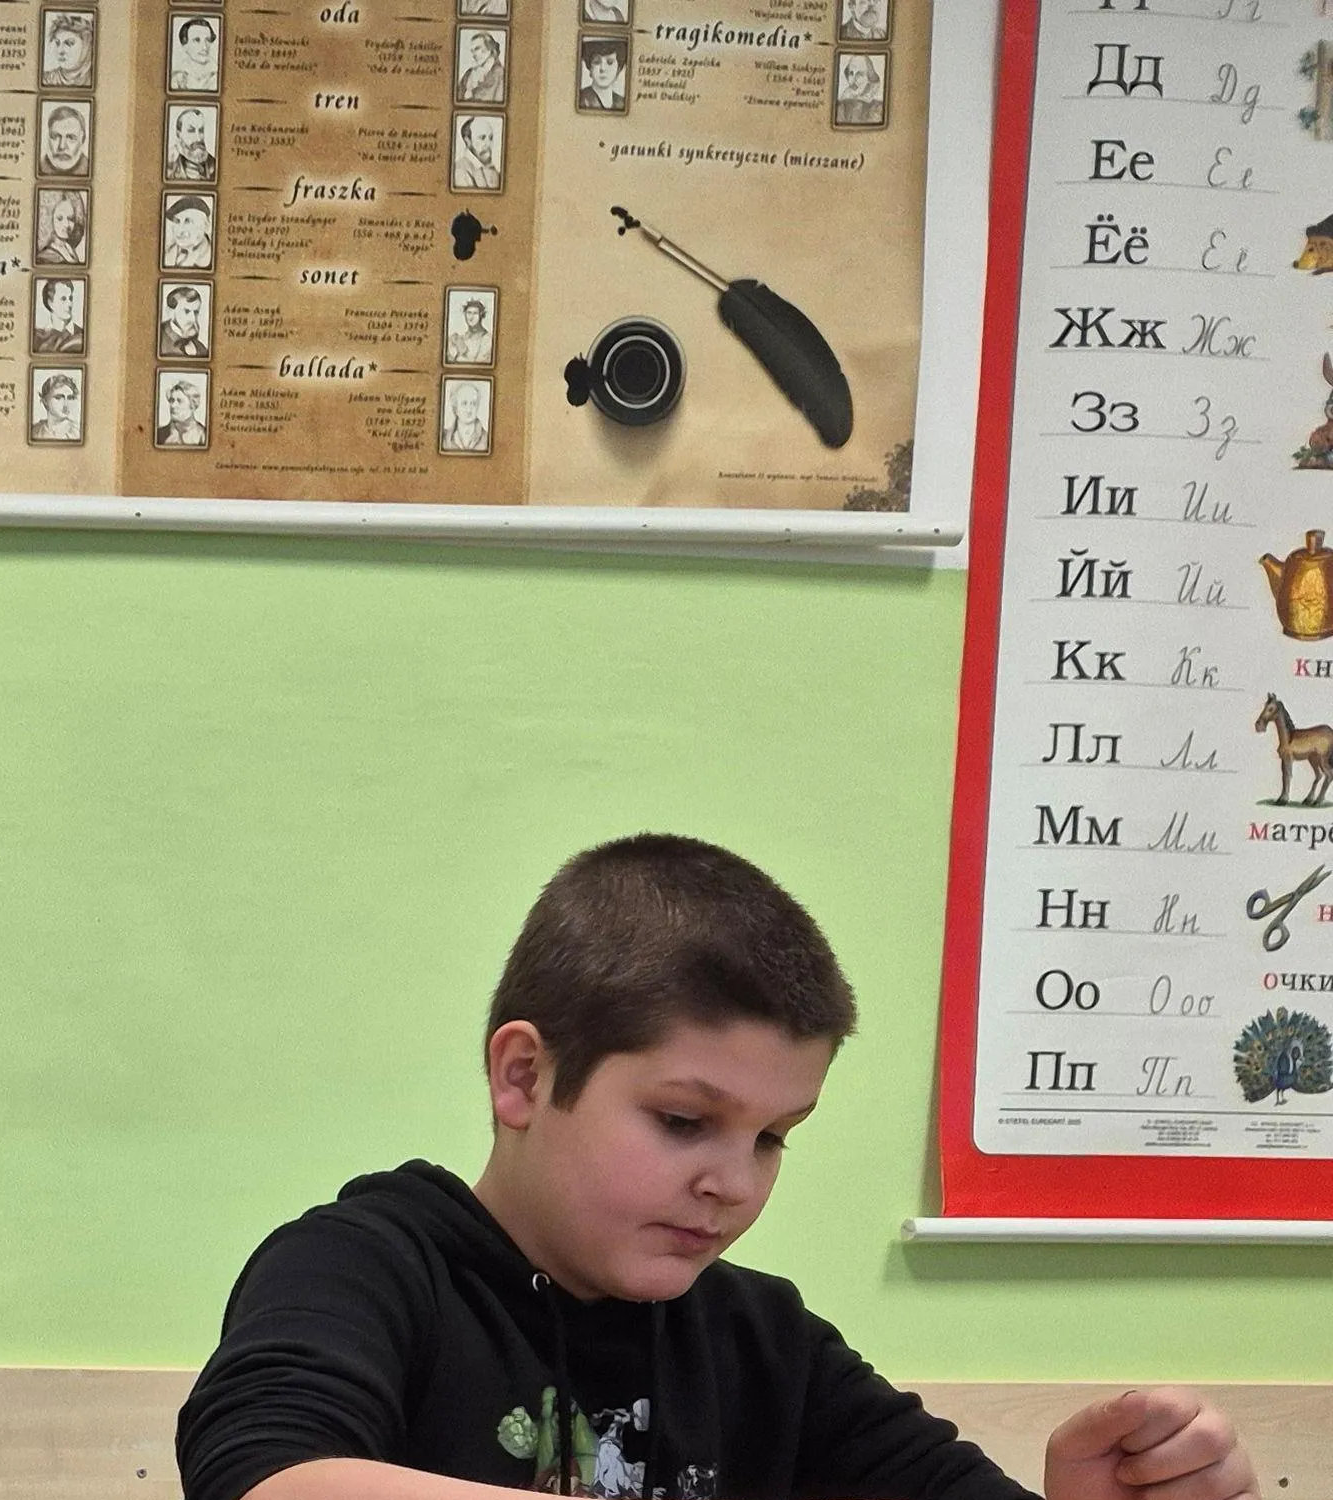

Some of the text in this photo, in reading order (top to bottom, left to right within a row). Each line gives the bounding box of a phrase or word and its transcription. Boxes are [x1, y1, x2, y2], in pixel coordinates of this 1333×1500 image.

[319, 0, 360, 24] oda
[1087, 43, 1165, 99] Дд
[314, 91, 360, 110] tren
[609, 140, 865, 171] gatunki synkretyczne (mieszane)
[1088, 139, 1155, 182] Ее
[283, 175, 377, 207] fraszka
[1083, 213, 1150, 266] Ёё
[299, 267, 360, 286] sonet
[1049, 307, 1167, 350] Жж
[1070, 391, 1140, 433] Зз
[1060, 474, 1139, 518] Ии
[1055, 547, 1133, 600] Йй
[1049, 638, 1127, 684] Кк
[1041, 721, 1122, 765] Лл
[1033, 804, 1123, 848] Мм
[1035, 887, 1110, 931] Нн
[1035, 968, 1101, 1013] Оо
[1025, 1050, 1098, 1092] Пп
